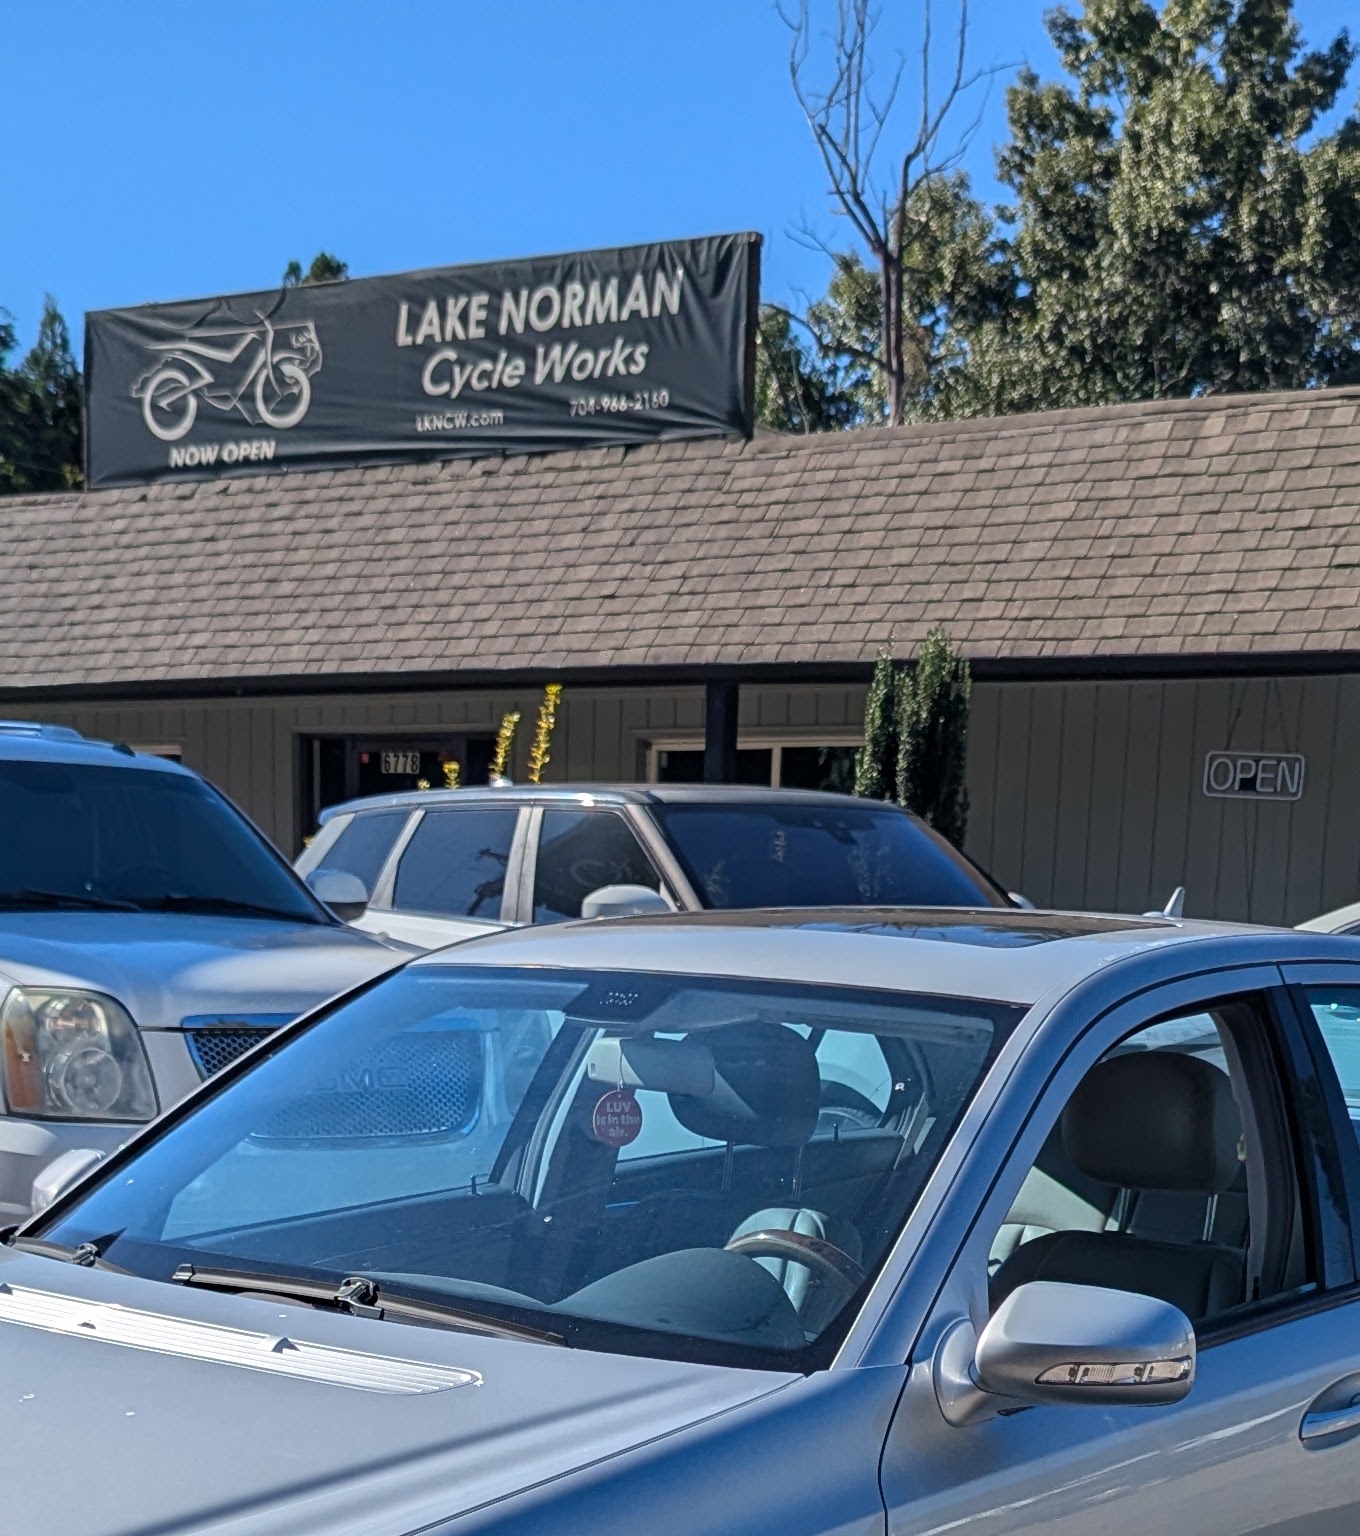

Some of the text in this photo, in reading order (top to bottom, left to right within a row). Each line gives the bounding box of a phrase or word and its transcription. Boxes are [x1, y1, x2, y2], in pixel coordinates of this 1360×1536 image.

[395, 266, 685, 348] LAKE NORMAN
[421, 335, 650, 400] Cycle Works
[568, 387, 670, 418] 704-966-2160
[415, 408, 505, 433] LKNCW.com
[169, 438, 277, 469] NOW OPEN
[383, 752, 419, 774] 6778
[1209, 756, 1301, 794] OPEN
[606, 1101, 631, 1113] LUV
